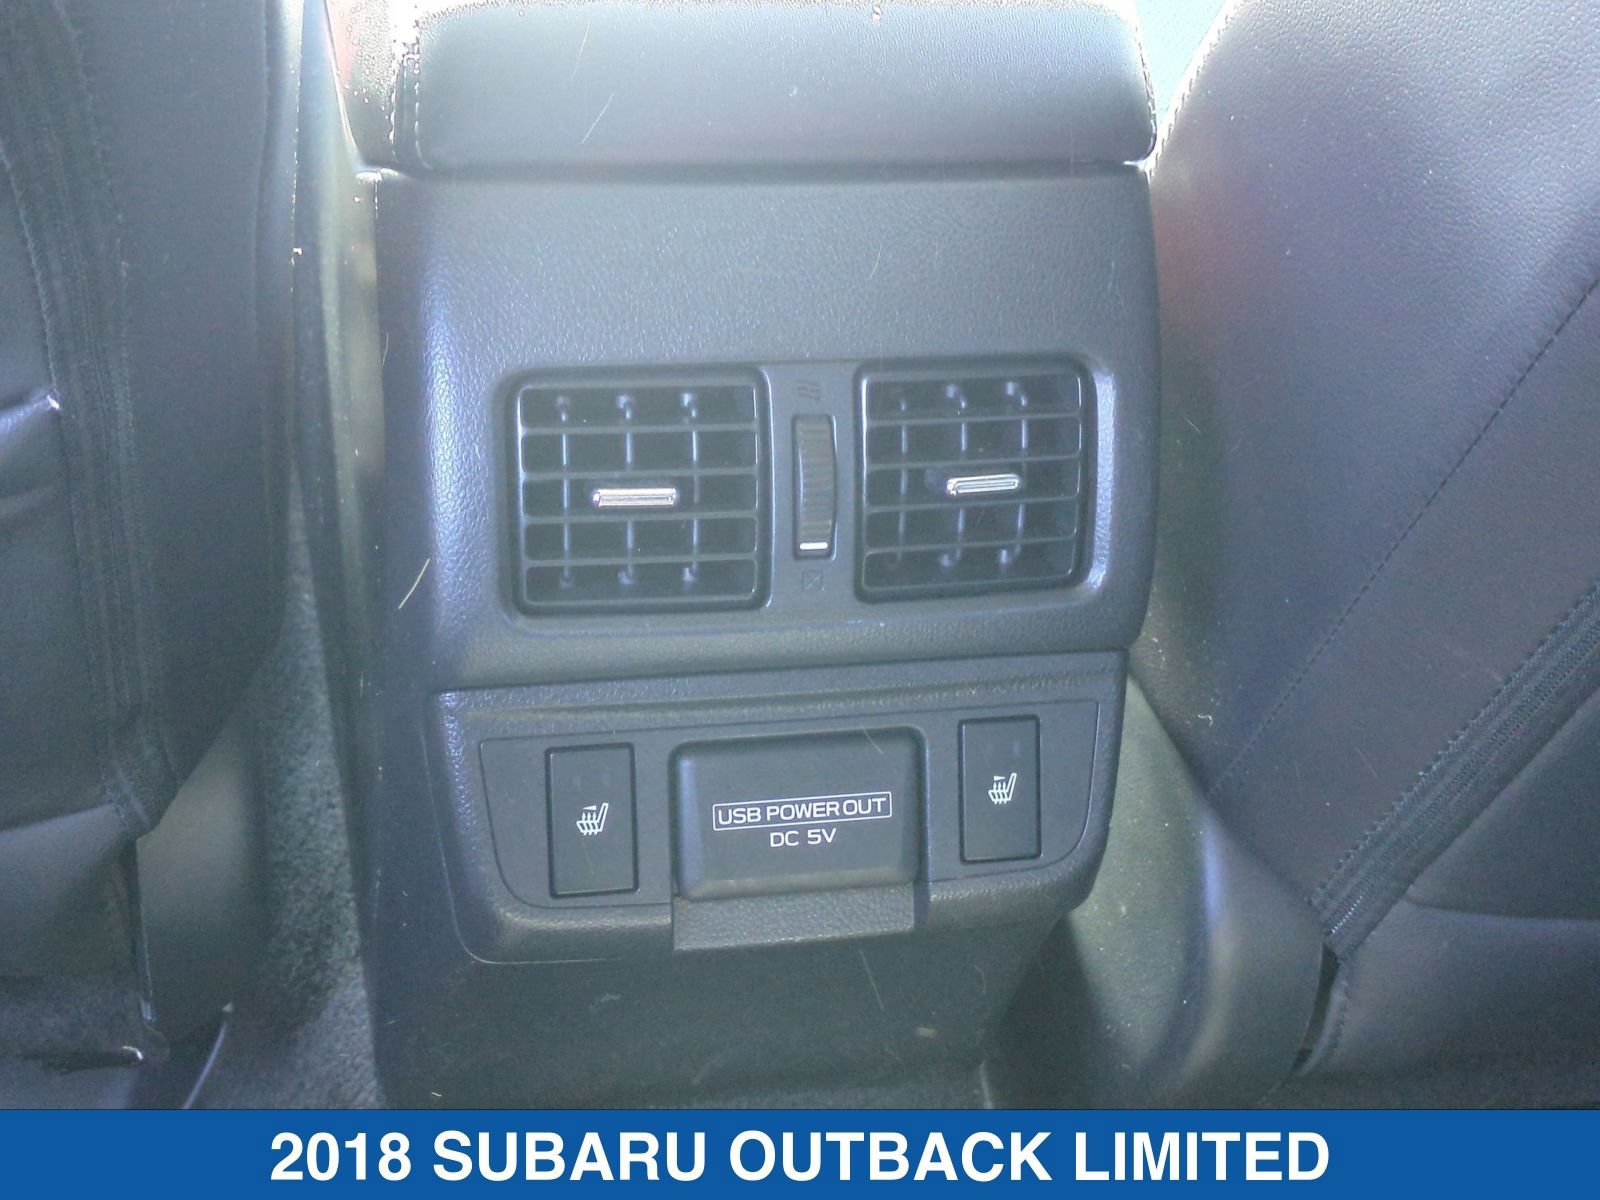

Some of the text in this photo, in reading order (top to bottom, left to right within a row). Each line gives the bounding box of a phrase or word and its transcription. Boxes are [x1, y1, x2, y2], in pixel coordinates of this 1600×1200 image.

[718, 797, 887, 825] USB POWER OUT
[769, 827, 837, 848] DC 5V
